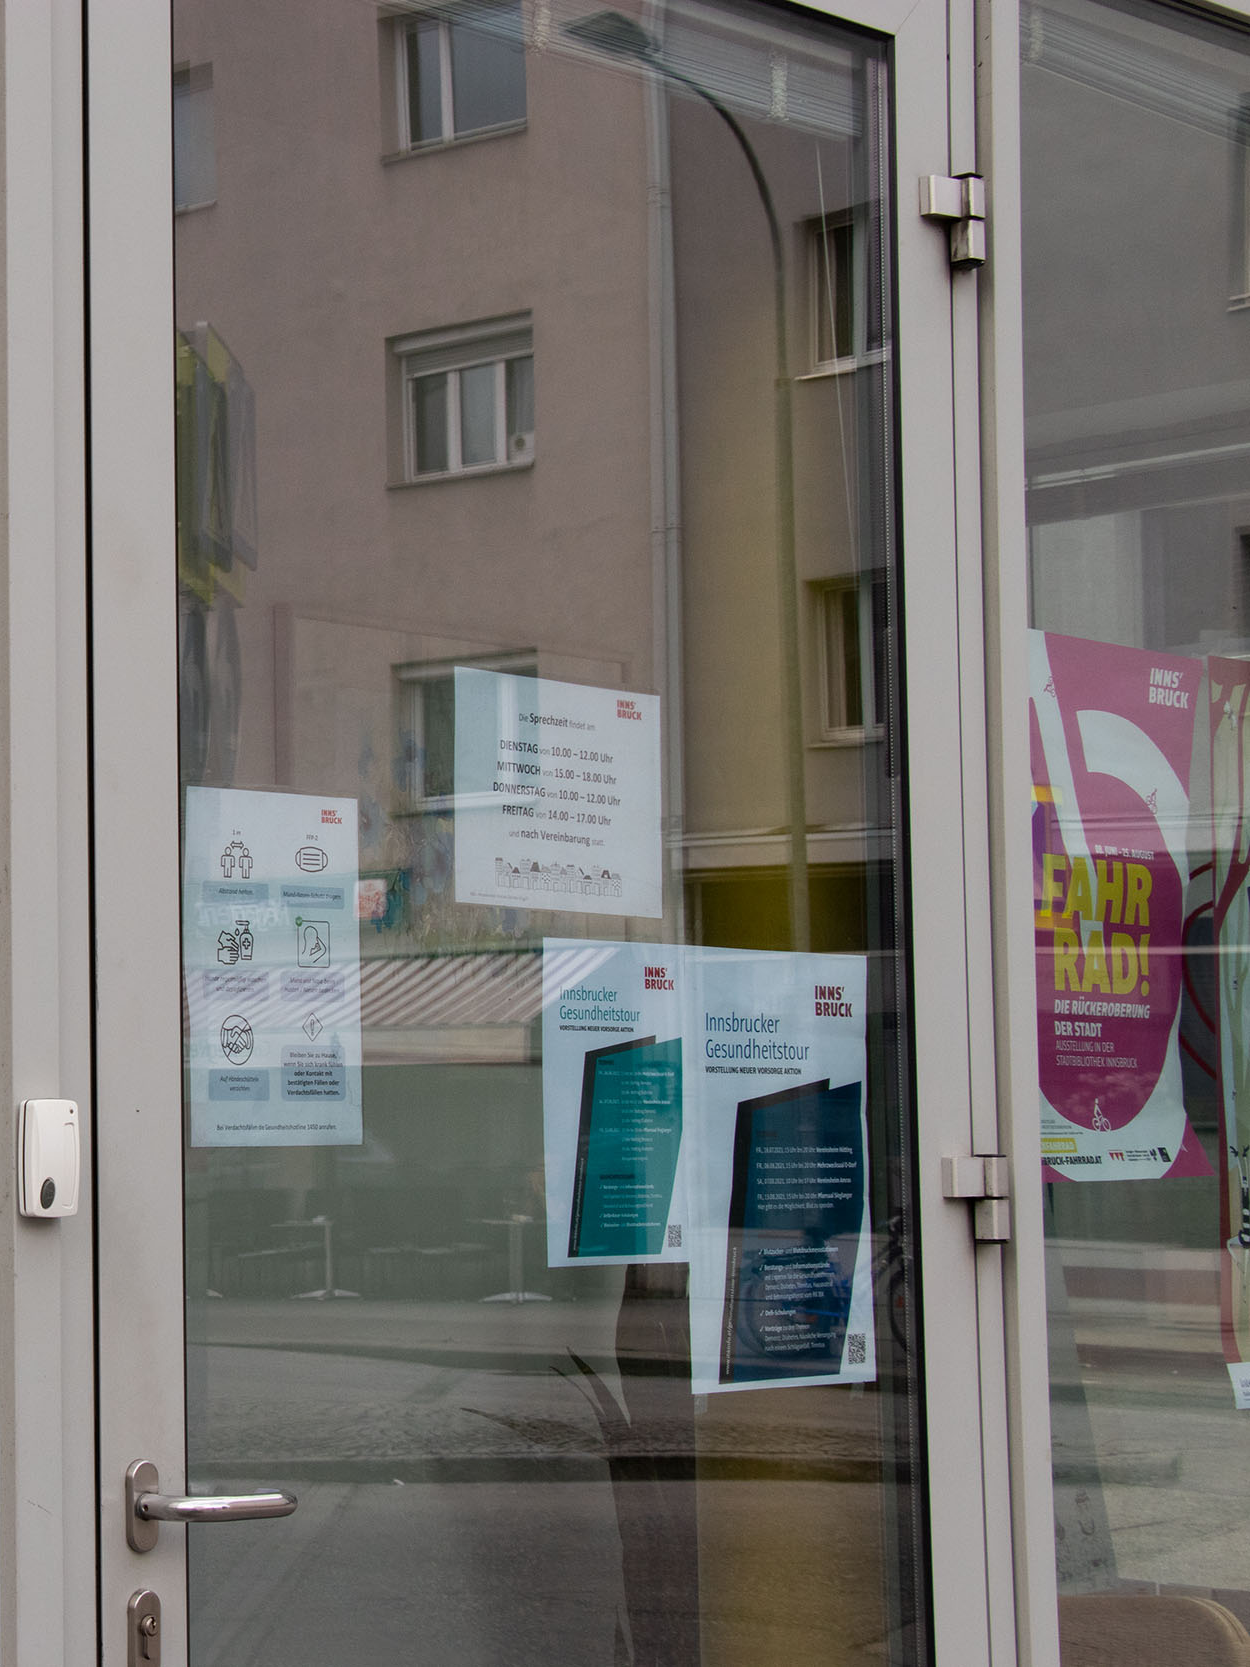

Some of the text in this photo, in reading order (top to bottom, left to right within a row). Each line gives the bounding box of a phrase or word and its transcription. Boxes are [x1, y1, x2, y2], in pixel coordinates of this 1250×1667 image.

[1149, 686, 1189, 709] BRUCK
[518, 712, 529, 722] Die
[530, 713, 568, 728] Sprechzeit
[617, 709, 642, 720] BRUCK
[500, 740, 538, 754] DIENSTAG
[551, 746, 571, 758] 10.00
[580, 750, 598, 762] 12.00
[600, 753, 614, 764] Uhr
[496, 761, 540, 776] MITTWOCH
[555, 768, 574, 780] 15.00
[582, 772, 602, 783] 18.00
[603, 775, 617, 785] Uhr
[493, 782, 545, 797] DONNERSTAG
[559, 790, 578, 801] 10.00
[586, 793, 606, 804] 12.00
[608, 796, 621, 806] Uhr
[321, 816, 342, 825] BRUCK
[502, 805, 534, 818] FREITAG
[548, 810, 568, 821] 14.00
[576, 813, 596, 825] 17.00
[598, 816, 611, 826] Uhr
[520, 830, 538, 840] nach
[540, 830, 590, 847] Vereinbarung
[1040, 853, 1152, 926] FAHR
[1054, 926, 1150, 996] RAD!
[644, 978, 674, 990] BRUCK
[560, 985, 618, 1002] Innsbrucker
[559, 1005, 641, 1022] Gesundheitstour
[815, 1002, 853, 1017] BRUCK
[1054, 996, 1150, 1019] DIE RÜCKEROBERUNG
[705, 1012, 780, 1033] Innsbrucker
[1054, 1020, 1102, 1038] DER STADT
[705, 1038, 810, 1060] Gesundheitstour
[1056, 1040, 1115, 1052] AUSSTELLUNG IN DER
[1056, 1054, 1138, 1069] STADTBIBLIOTHEK INNSBRUCK
[705, 1066, 739, 1074] VORSTELLUNG
[740, 1066, 756, 1074] NEUER
[784, 1067, 802, 1075] AKTION
